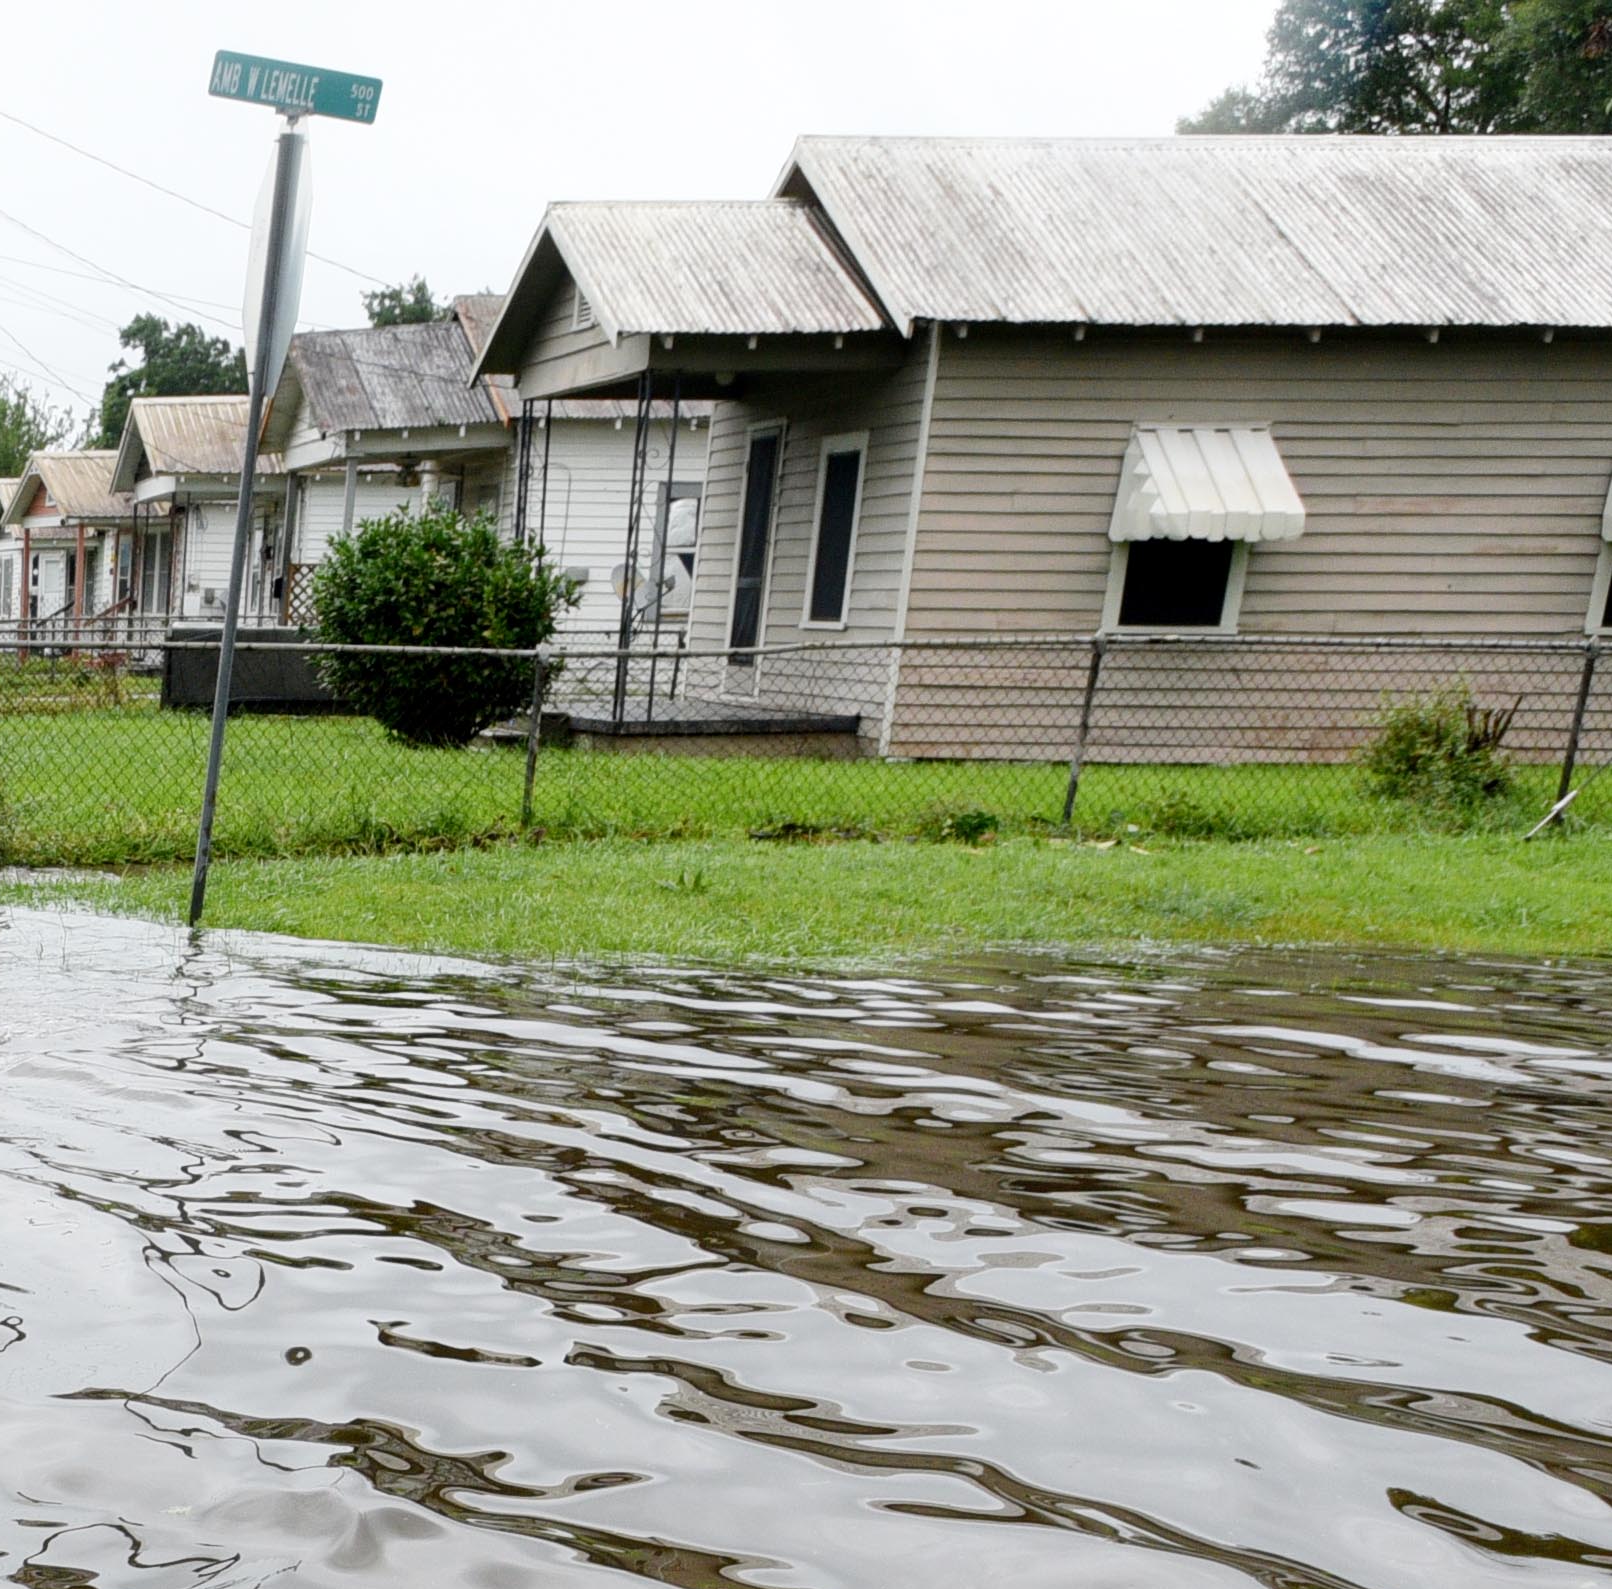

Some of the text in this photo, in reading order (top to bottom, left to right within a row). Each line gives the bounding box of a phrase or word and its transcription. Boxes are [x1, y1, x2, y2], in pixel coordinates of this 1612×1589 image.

[211, 61, 320, 107] AMB W LEMELLE
[350, 83, 374, 100] 500
[355, 103, 371, 119] ST
